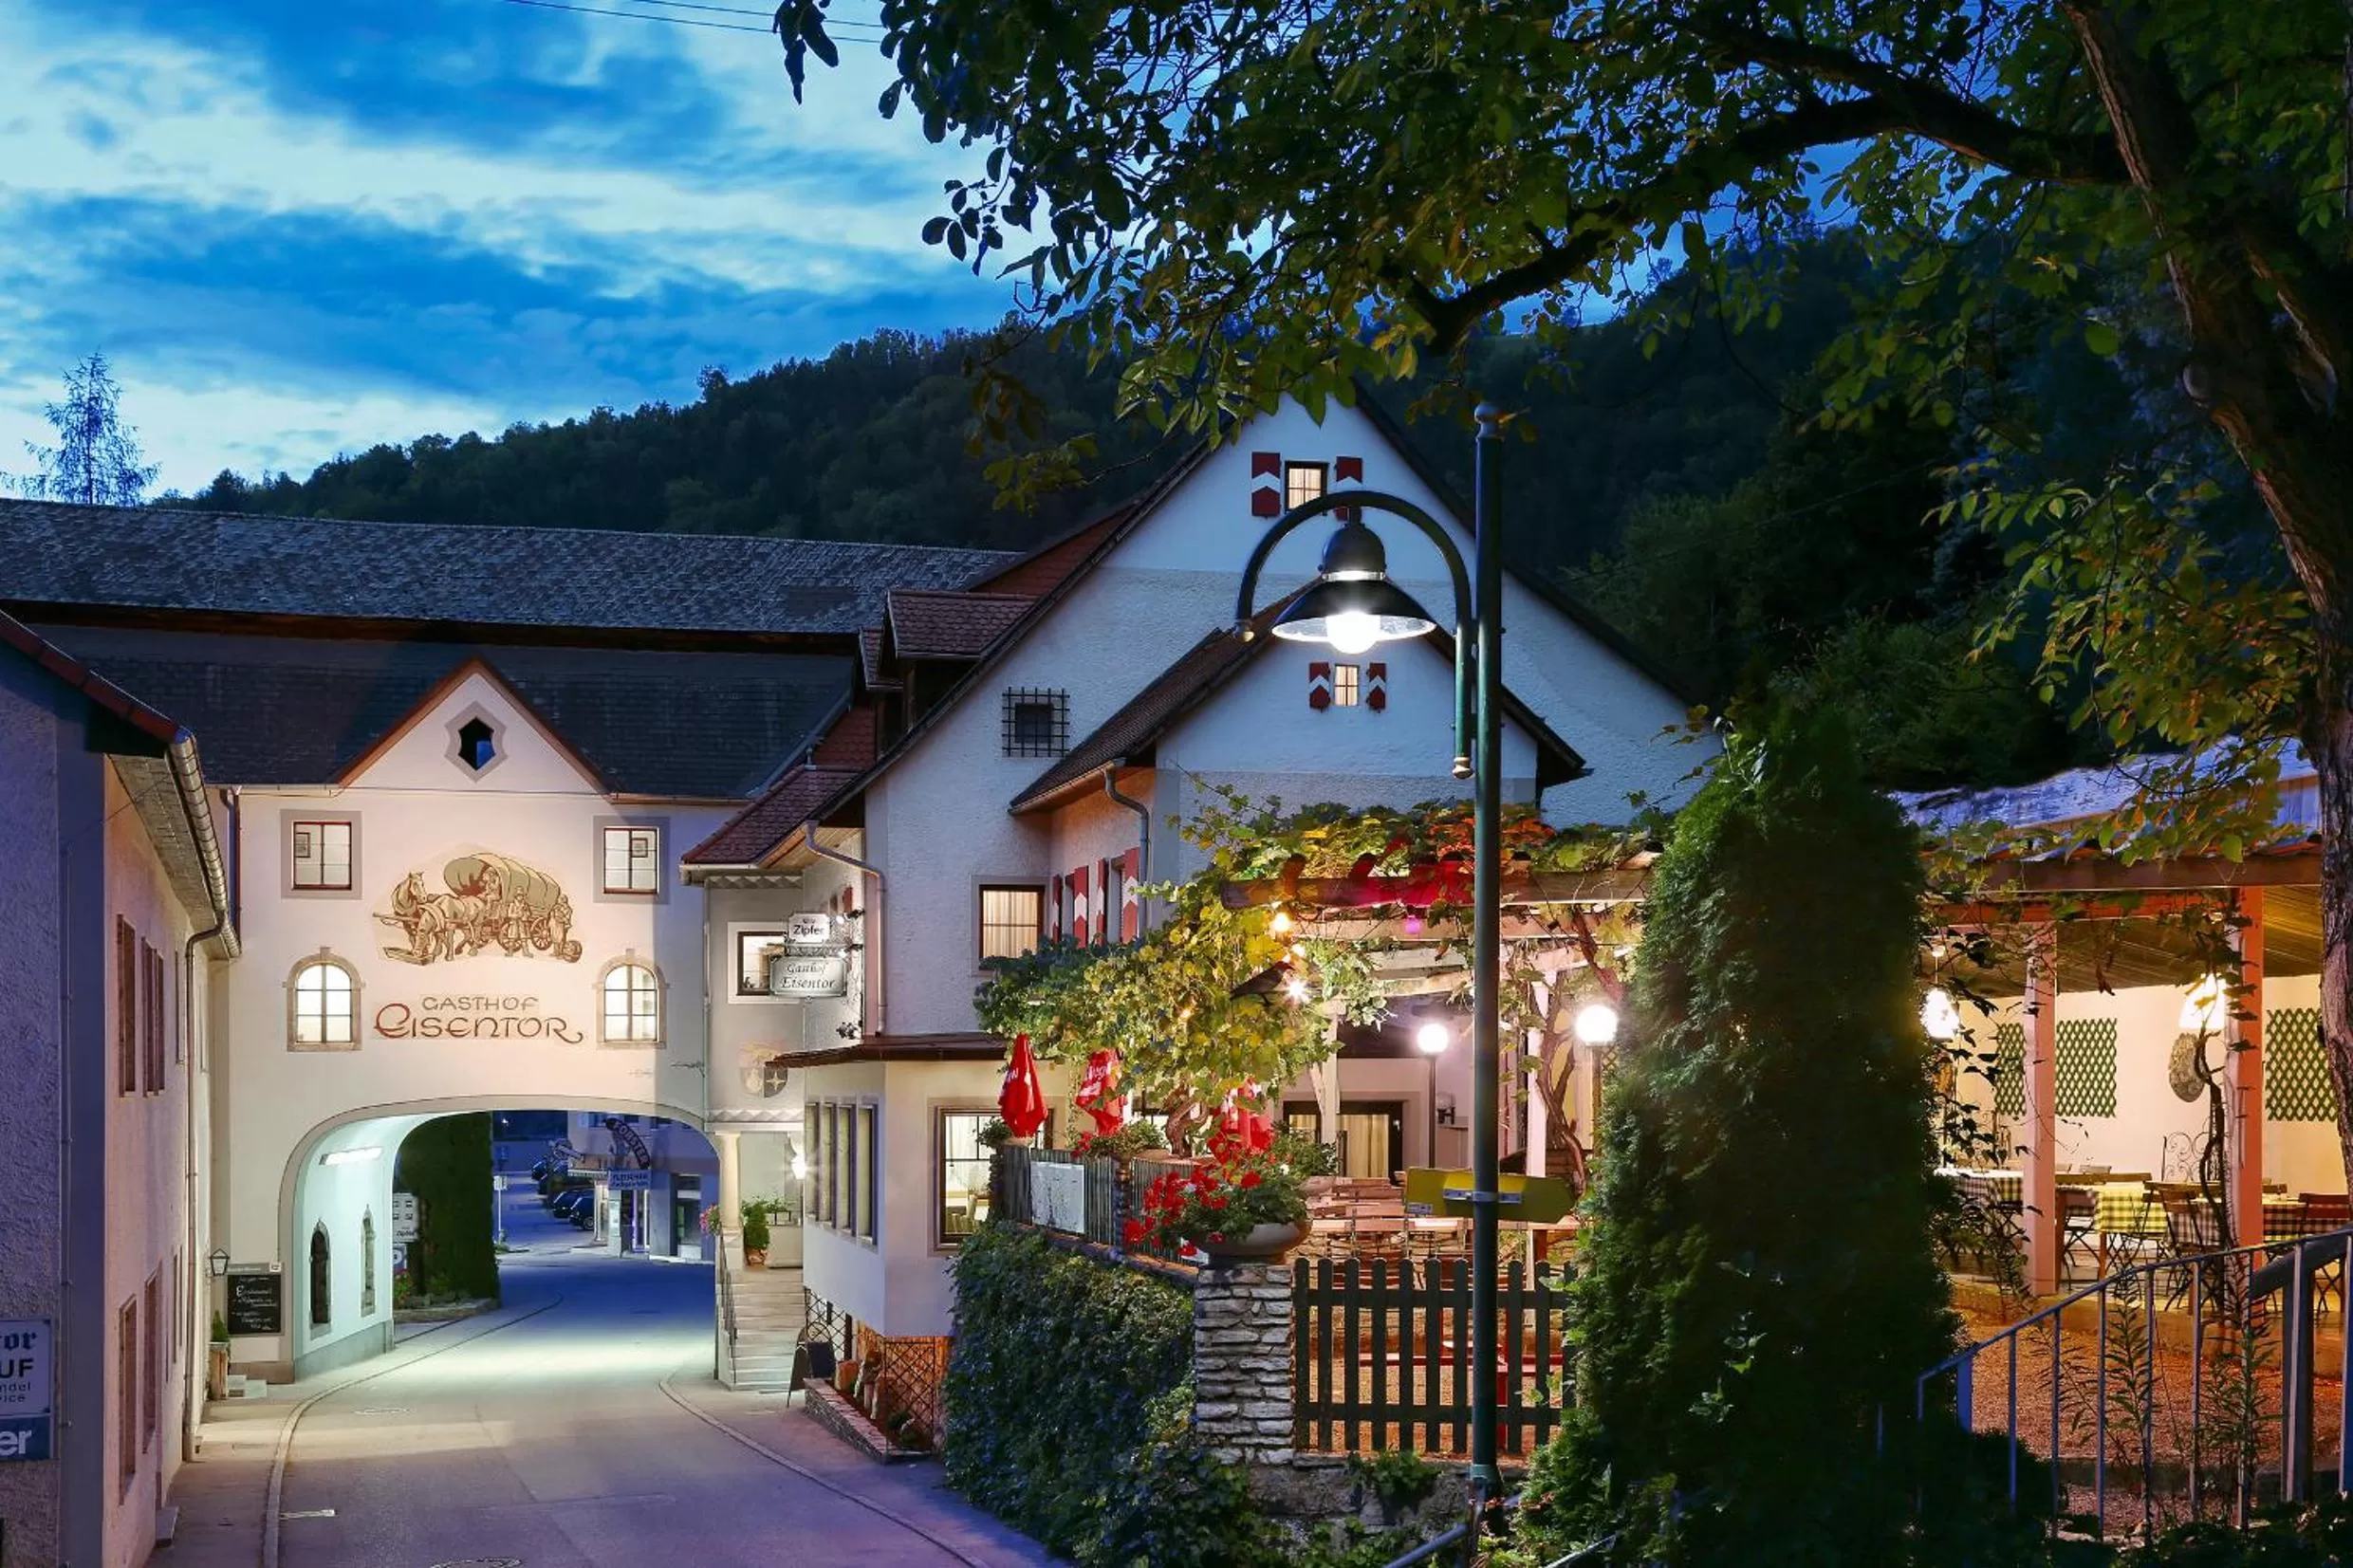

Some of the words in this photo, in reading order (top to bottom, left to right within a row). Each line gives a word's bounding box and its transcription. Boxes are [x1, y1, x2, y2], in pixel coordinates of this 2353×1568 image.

[793, 924, 824, 937] Zipfer
[422, 996, 538, 1011] GASTHOF
[0, 1332, 37, 1351] or
